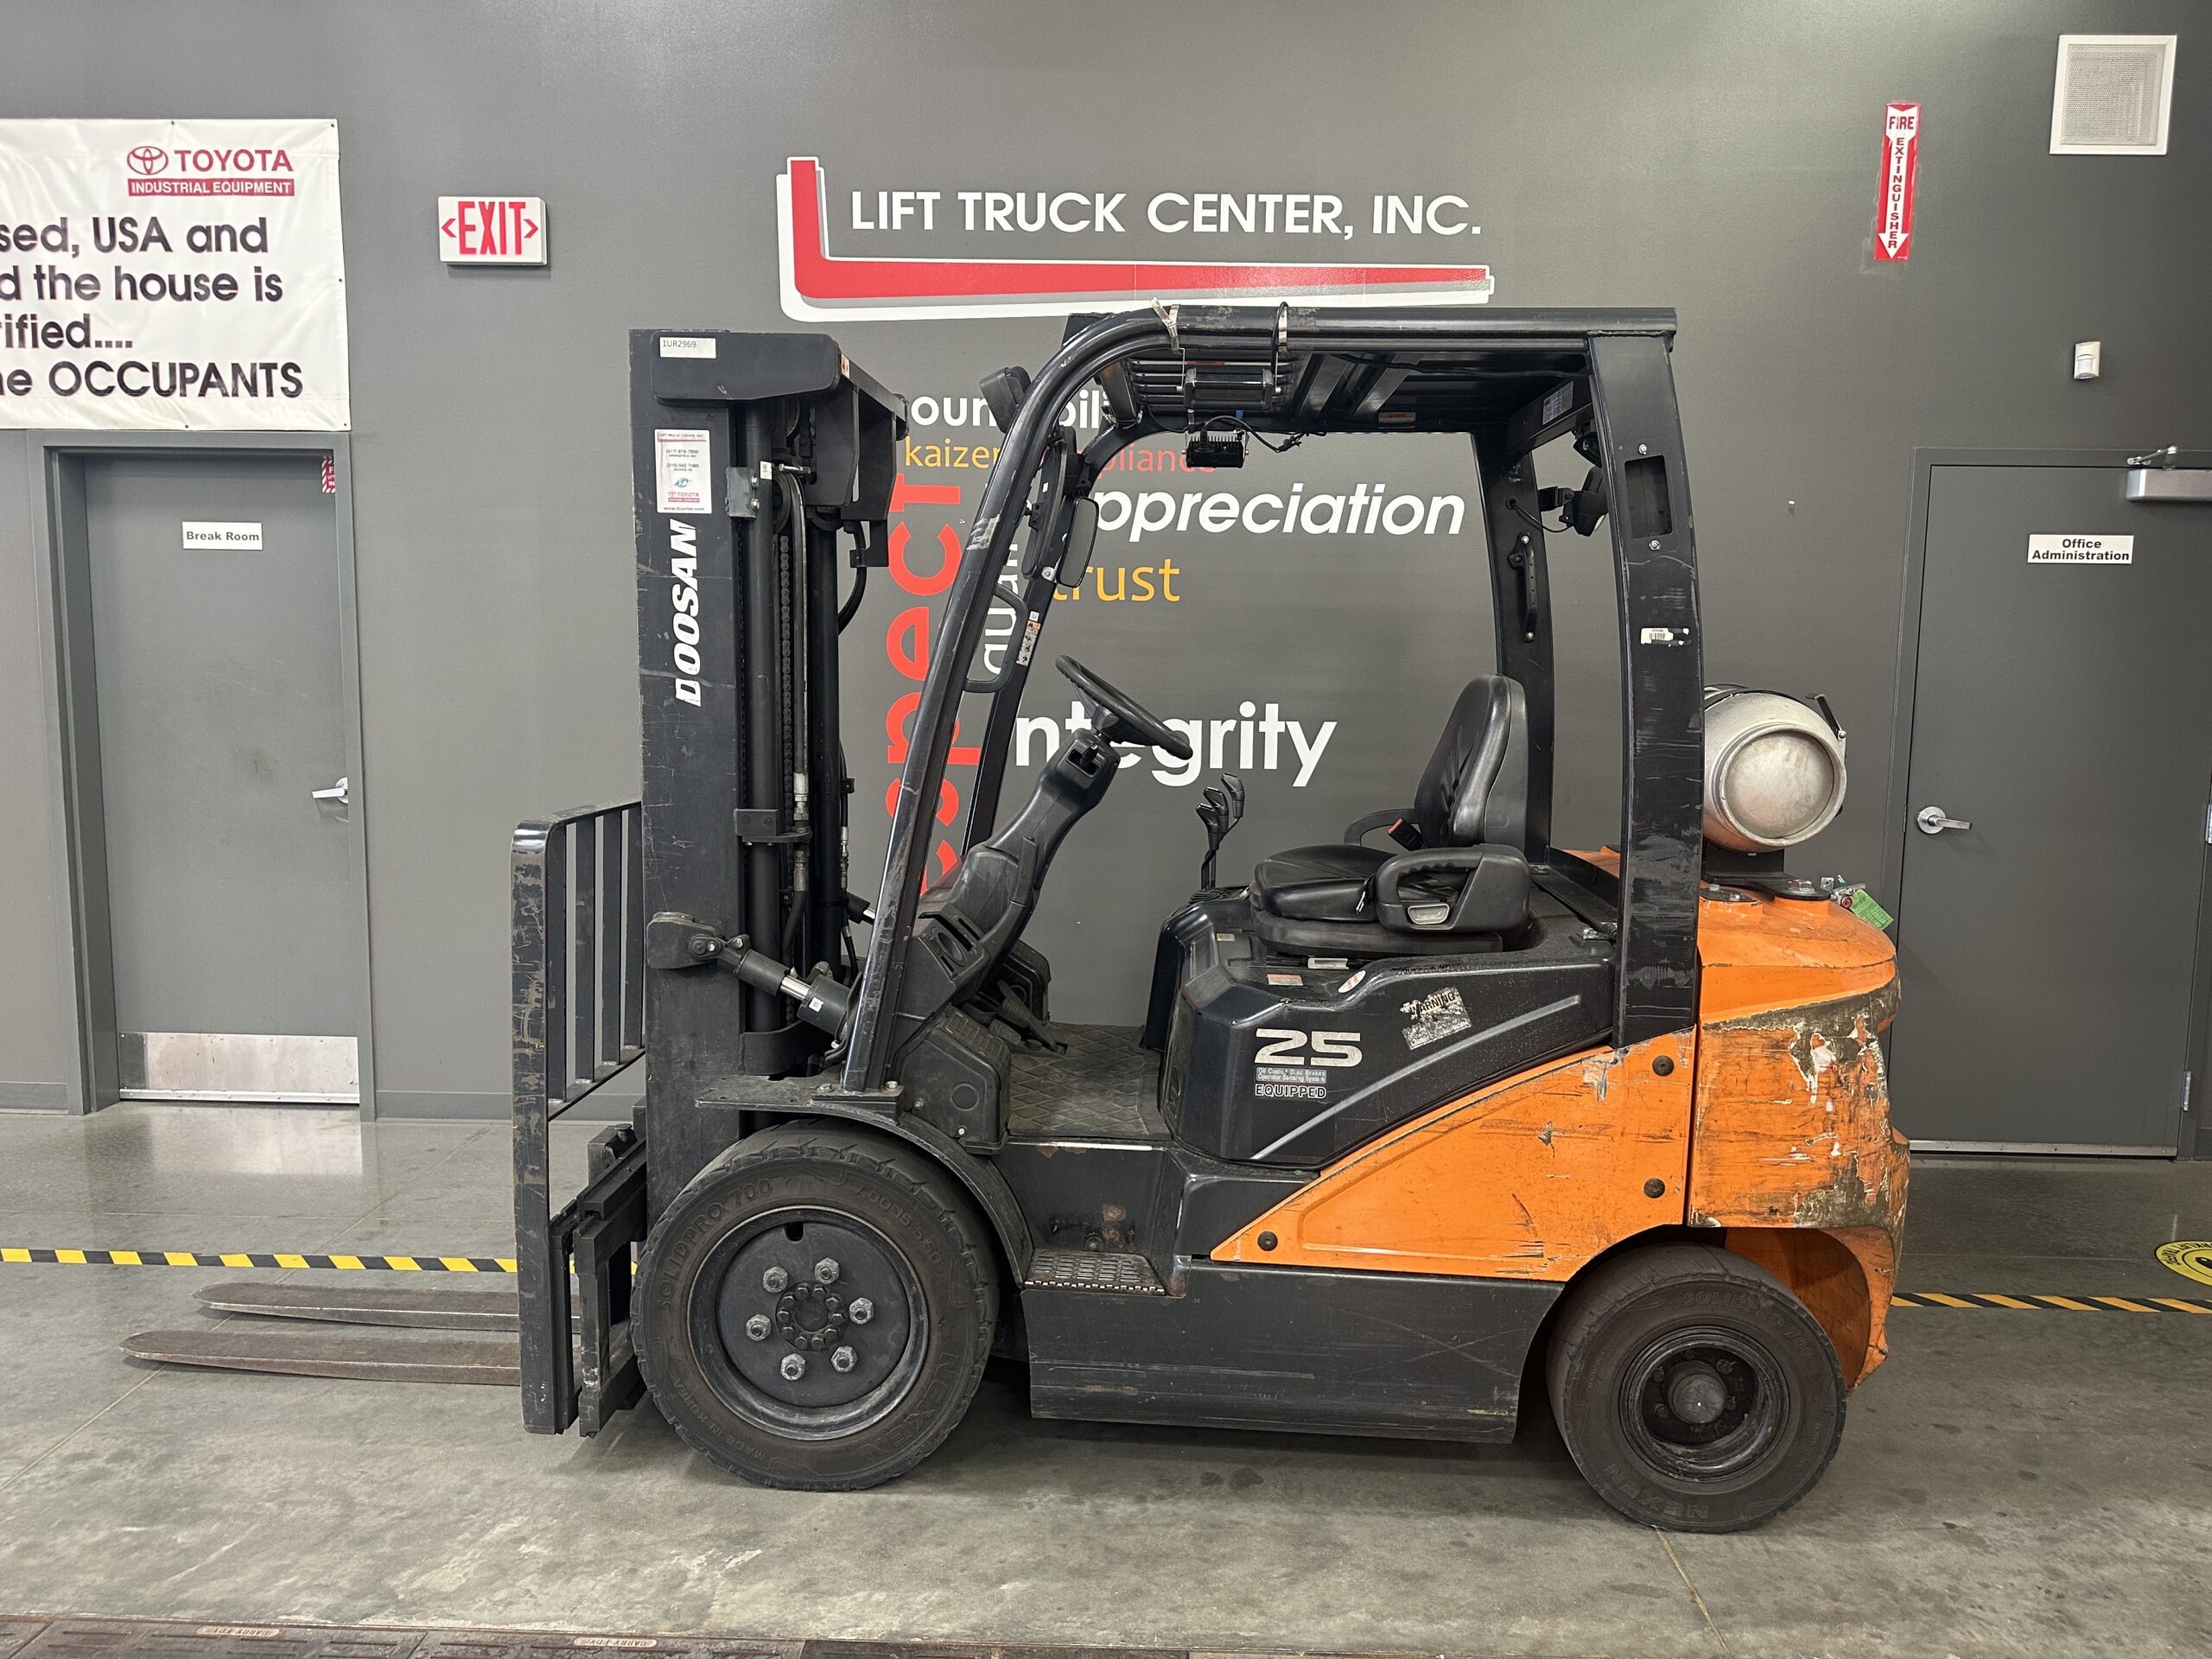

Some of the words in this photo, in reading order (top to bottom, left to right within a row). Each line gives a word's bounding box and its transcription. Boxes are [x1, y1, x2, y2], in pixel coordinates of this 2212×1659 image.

[1889, 116, 1915, 130] FIRE
[174, 149, 293, 173] TOYOTA
[131, 181, 211, 194] INDUSTRIAL
[213, 181, 291, 194] EQUIPMENT
[1888, 137, 1905, 249] EXTINGUISHER
[458, 200, 526, 256] EXIT
[851, 190, 942, 232] LIFT
[957, 191, 1128, 233] TRUCK
[1147, 192, 1355, 241] CENTER,
[1372, 194, 1482, 236] INC.
[92, 216, 174, 253] USA
[186, 217, 269, 253] and
[33, 264, 101, 301] the
[114, 265, 239, 302] house
[254, 265, 283, 302] is
[48, 359, 304, 399] OCCUPANTS
[186, 531, 222, 541] Break
[226, 531, 259, 542] Room
[2062, 538, 2102, 549] Office
[2031, 550, 2130, 561] Administration
[670, 518, 702, 708] DOOSAN
[1254, 1027, 1363, 1067] 25
[1255, 1084, 1327, 1099] EQUIPPED
